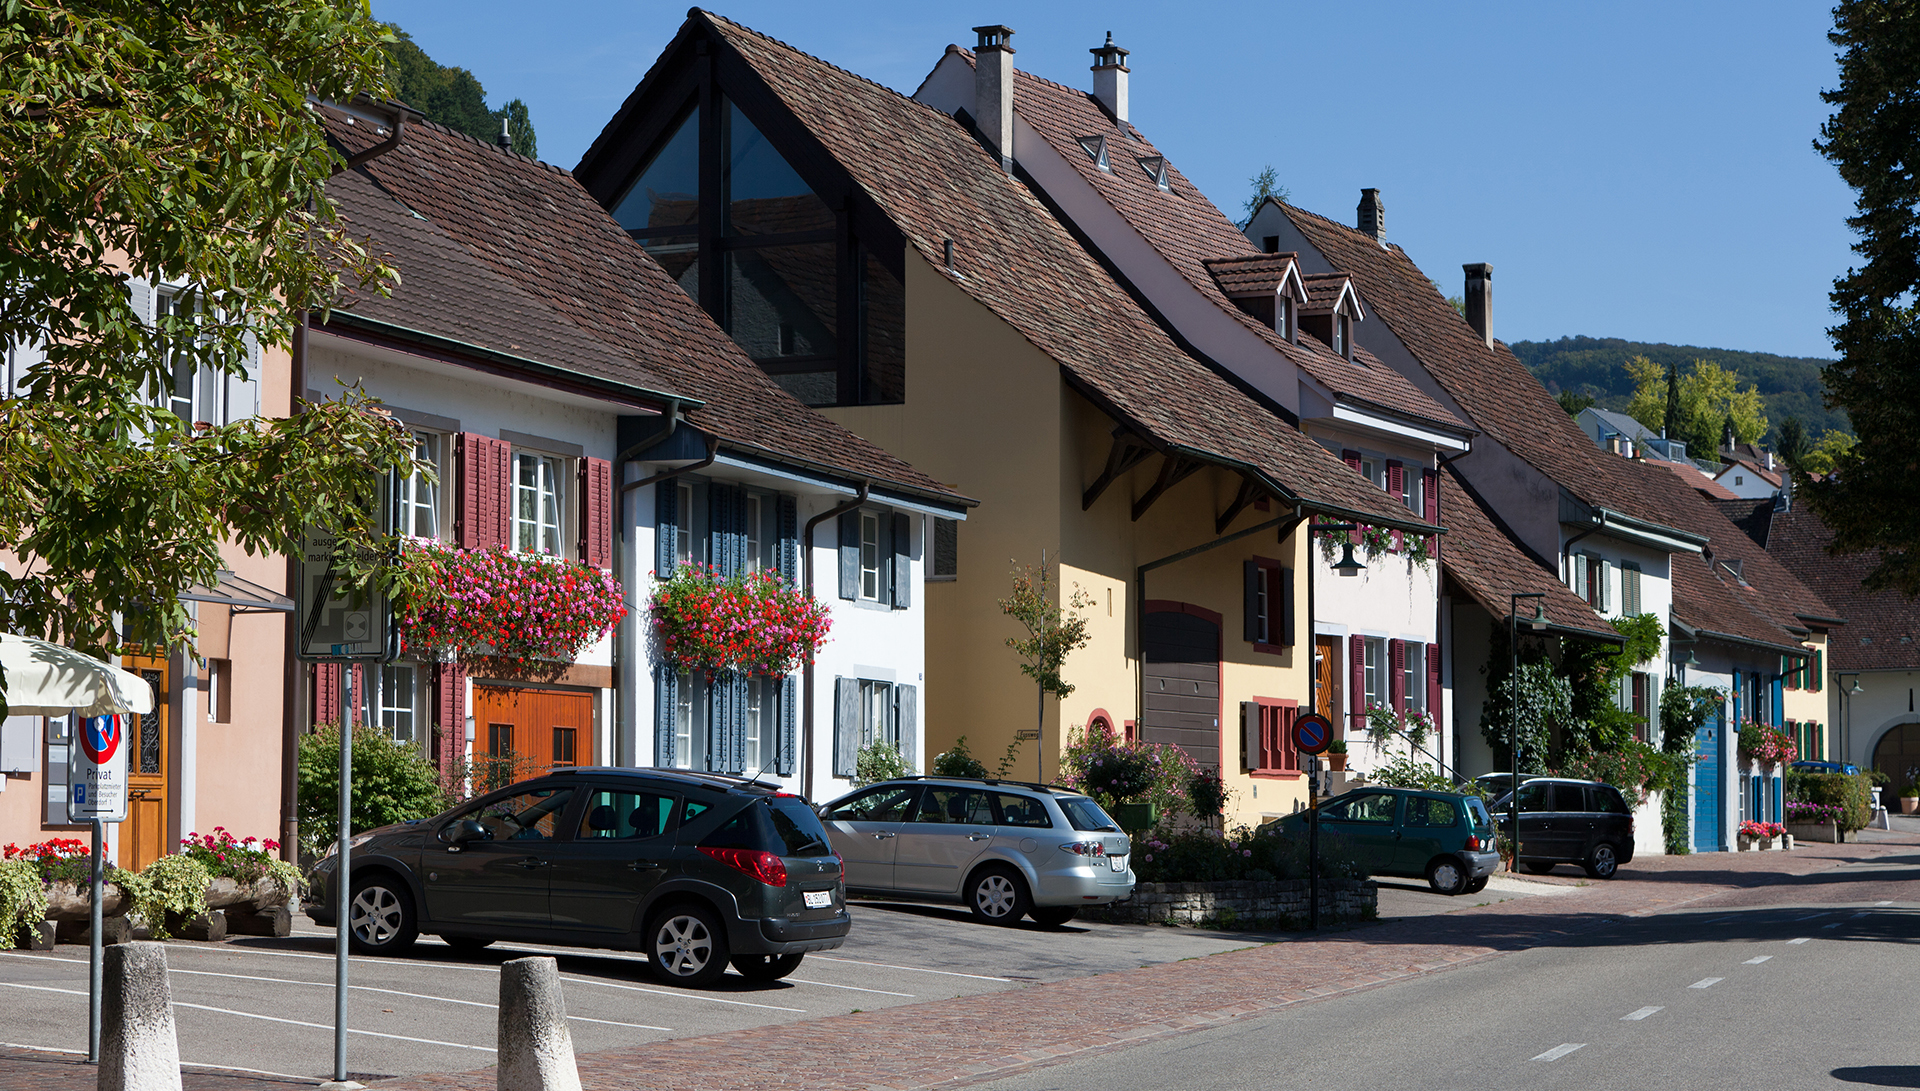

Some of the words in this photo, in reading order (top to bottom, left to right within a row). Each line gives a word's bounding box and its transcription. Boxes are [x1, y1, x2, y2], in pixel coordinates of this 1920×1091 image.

[86, 768, 112, 780] Privat
[88, 782, 121, 790] Parkplatzmieter
[77, 786, 84, 802] P
[88, 790, 98, 798] und
[98, 790, 118, 798] Besucher
[88, 798, 108, 806] Oberdorf
